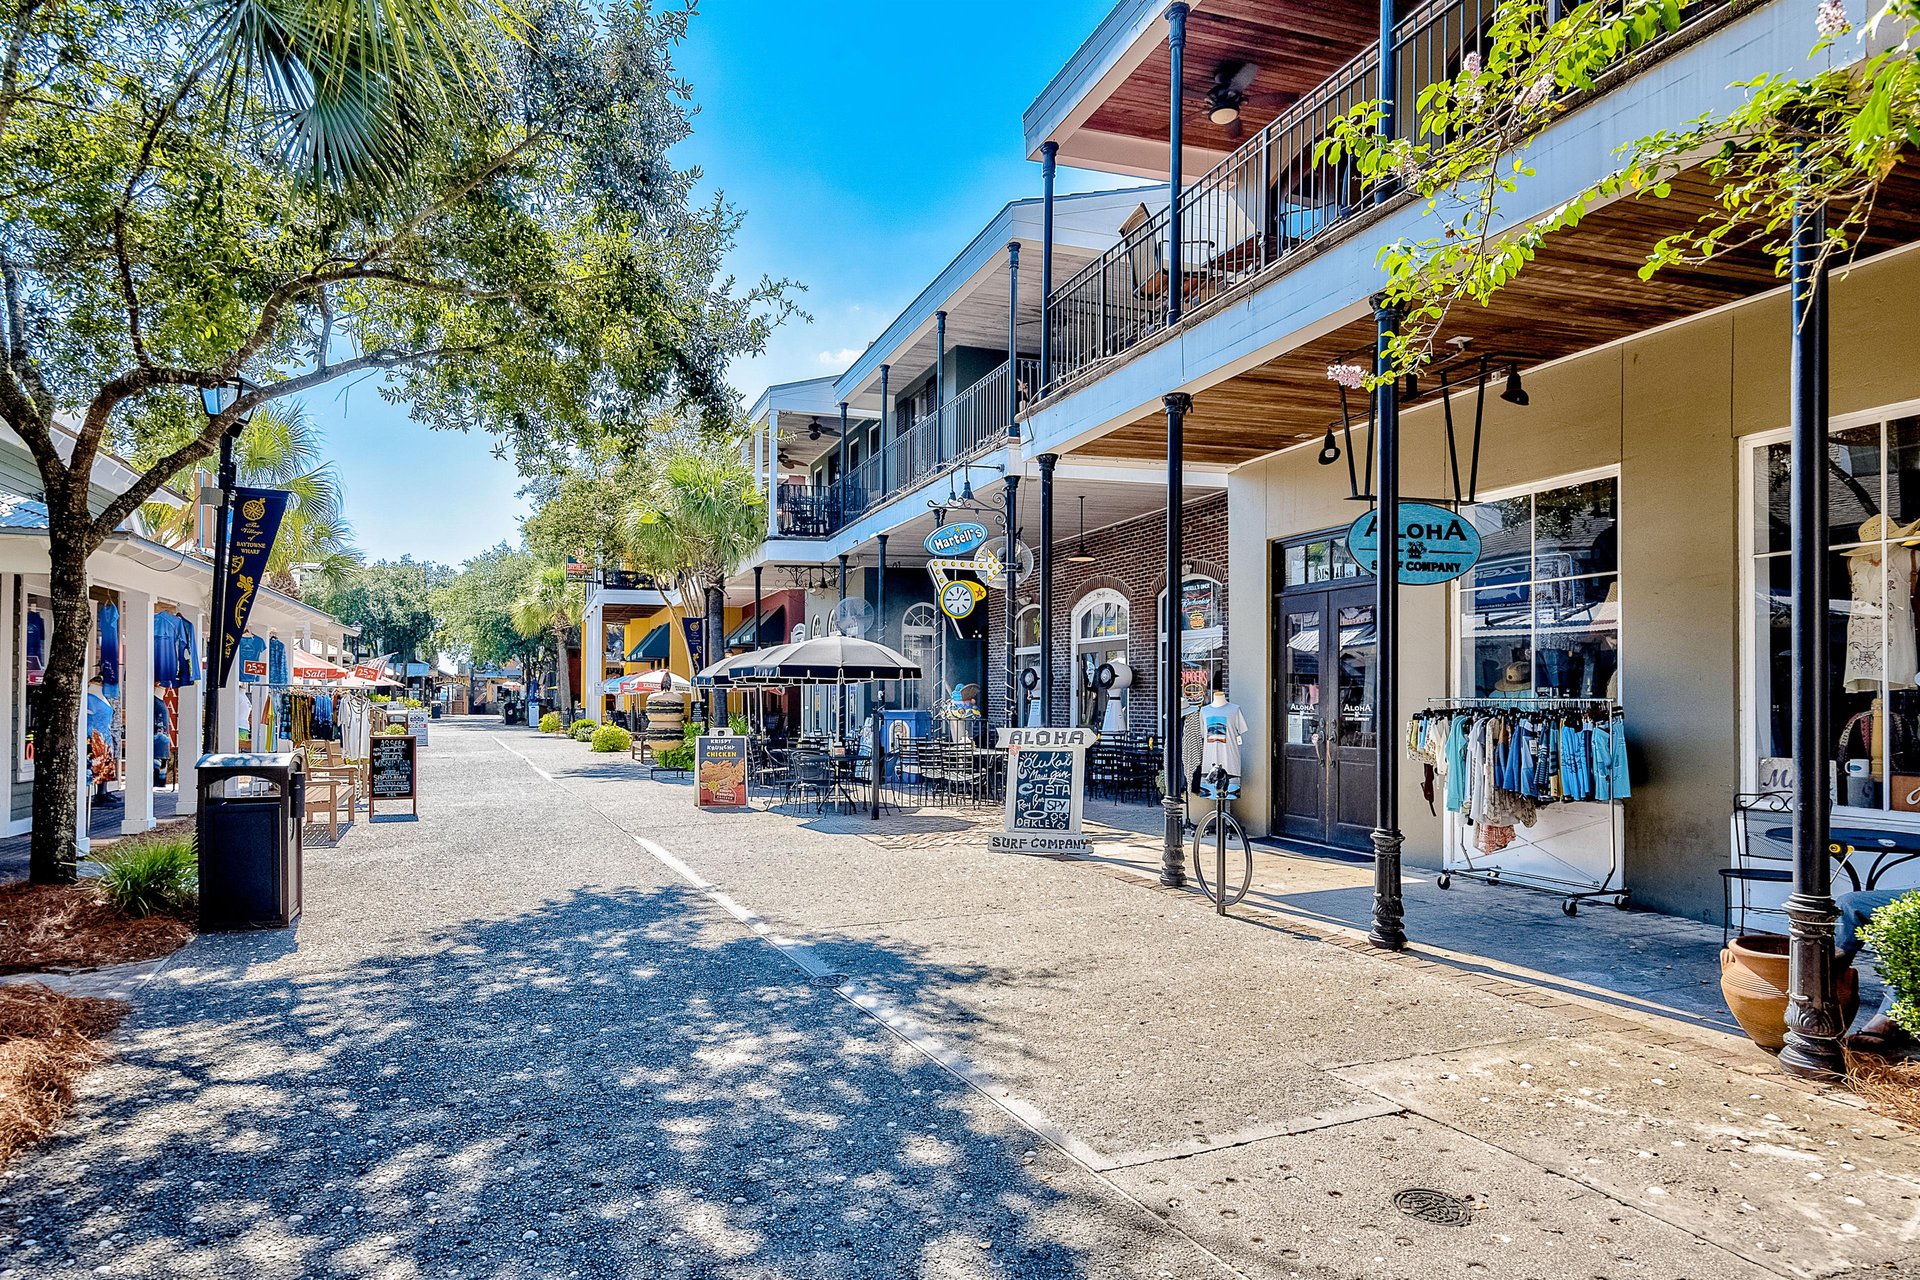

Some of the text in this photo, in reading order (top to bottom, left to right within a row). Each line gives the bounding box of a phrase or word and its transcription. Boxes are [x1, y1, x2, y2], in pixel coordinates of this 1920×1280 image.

[933, 528, 983, 551] Hartell's
[1405, 561, 1461, 573] COMPANY
[304, 669, 326, 678] Sale
[358, 668, 375, 677] 25%
[1290, 703, 1315, 711] ALOHA
[1343, 703, 1372, 712] ALOHA
[1009, 730, 1084, 746] ALOHA
[1018, 783, 1071, 796] COSTA
[1046, 800, 1067, 811] SPY
[1016, 817, 1058, 828] OAKLEY
[992, 836, 1088, 850] SURF COMPANY
